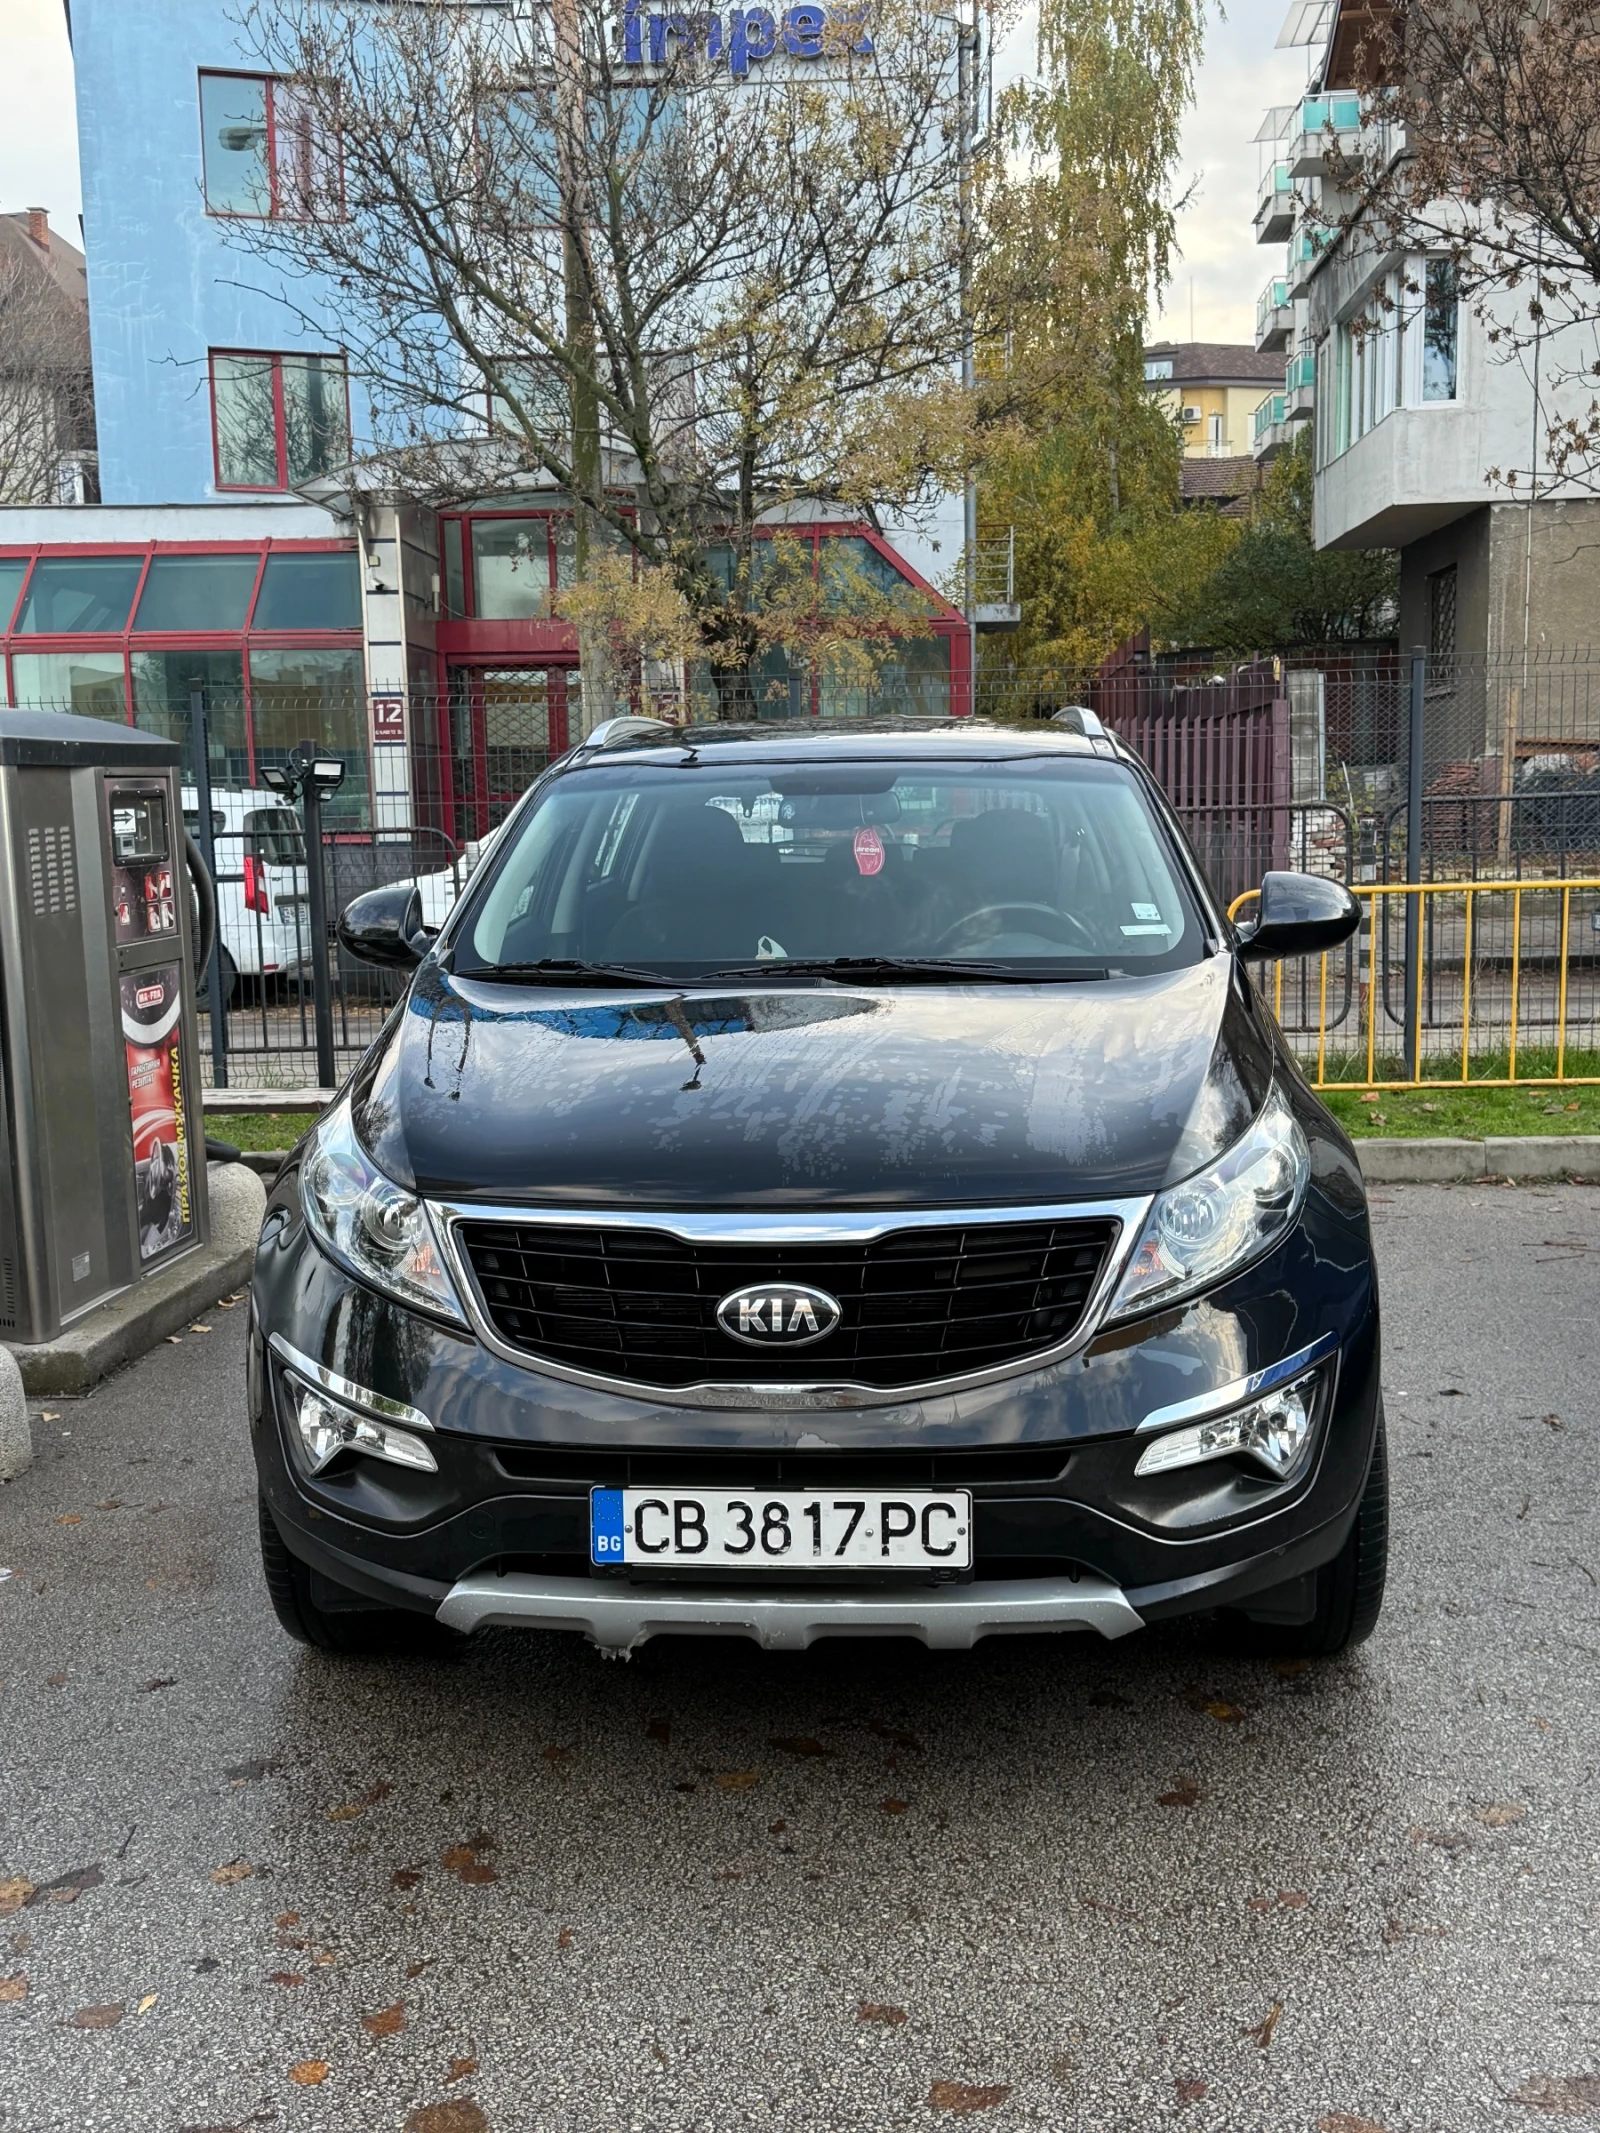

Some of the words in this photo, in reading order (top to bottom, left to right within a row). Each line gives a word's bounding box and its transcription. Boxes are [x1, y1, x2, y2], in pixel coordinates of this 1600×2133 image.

[375, 703, 402, 723] 12
[171, 1046, 191, 1223] ПРАХОСМУКАЧКА
[738, 1298, 819, 1331] KIA
[597, 1535, 621, 1552] BG
[633, 1498, 710, 1555] CB
[723, 1500, 866, 1557] 3817
[881, 1501, 957, 1557] PC
